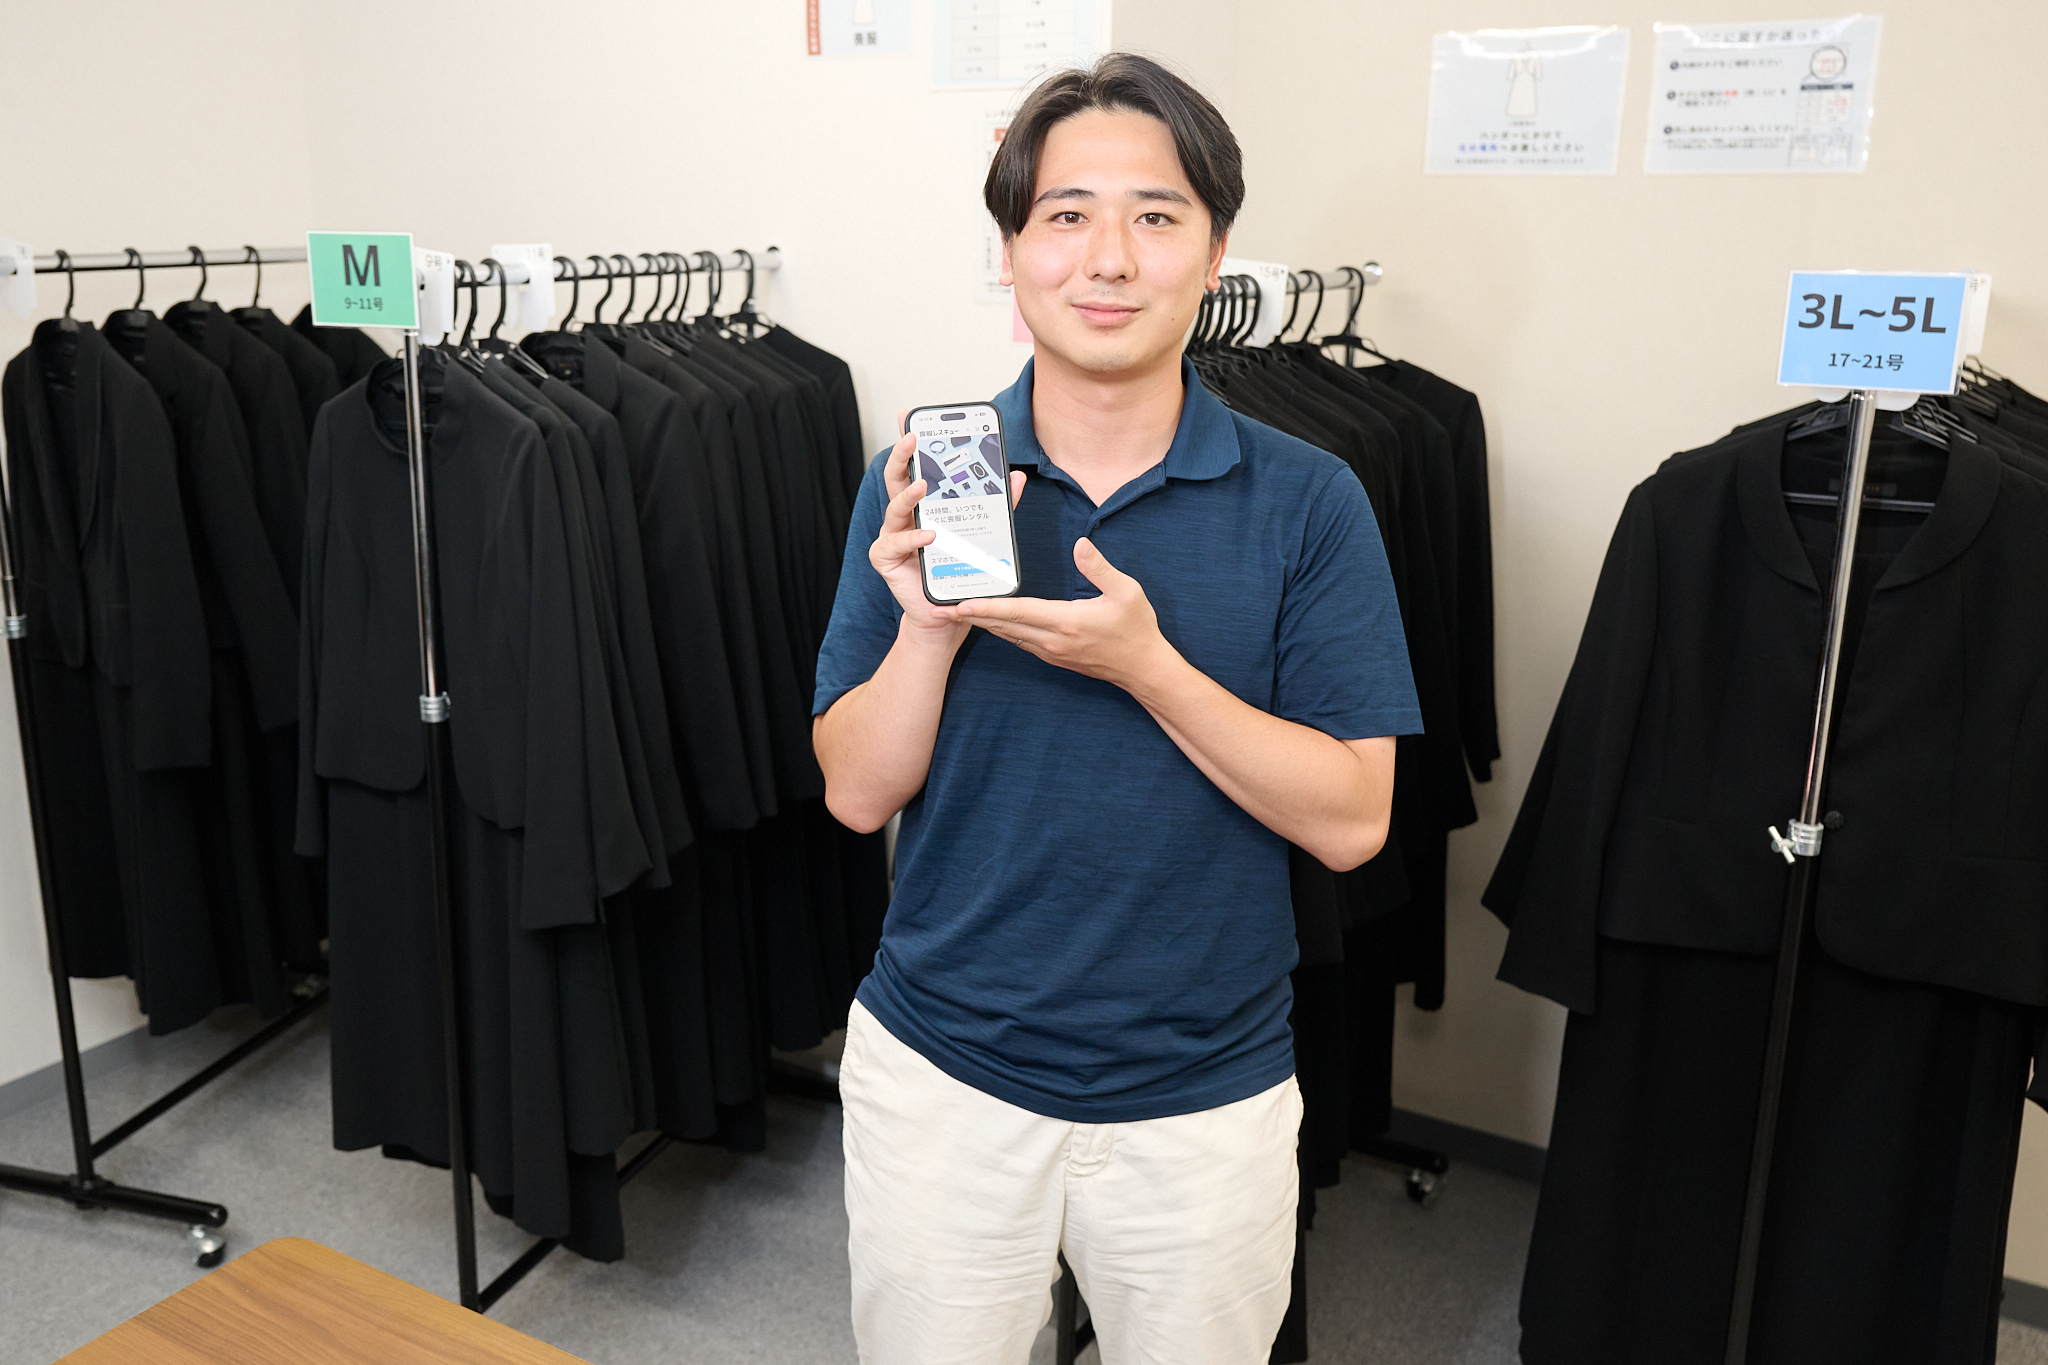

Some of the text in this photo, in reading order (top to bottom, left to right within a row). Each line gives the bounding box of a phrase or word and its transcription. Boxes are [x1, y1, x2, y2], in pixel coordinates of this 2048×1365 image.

[342, 244, 381, 287] M
[344, 297, 384, 311] 9~11号
[1798, 293, 1947, 334] 3L~5L
[1828, 353, 1904, 371] 17~21号
[928, 513, 990, 524] ぐに喪服レンタル
